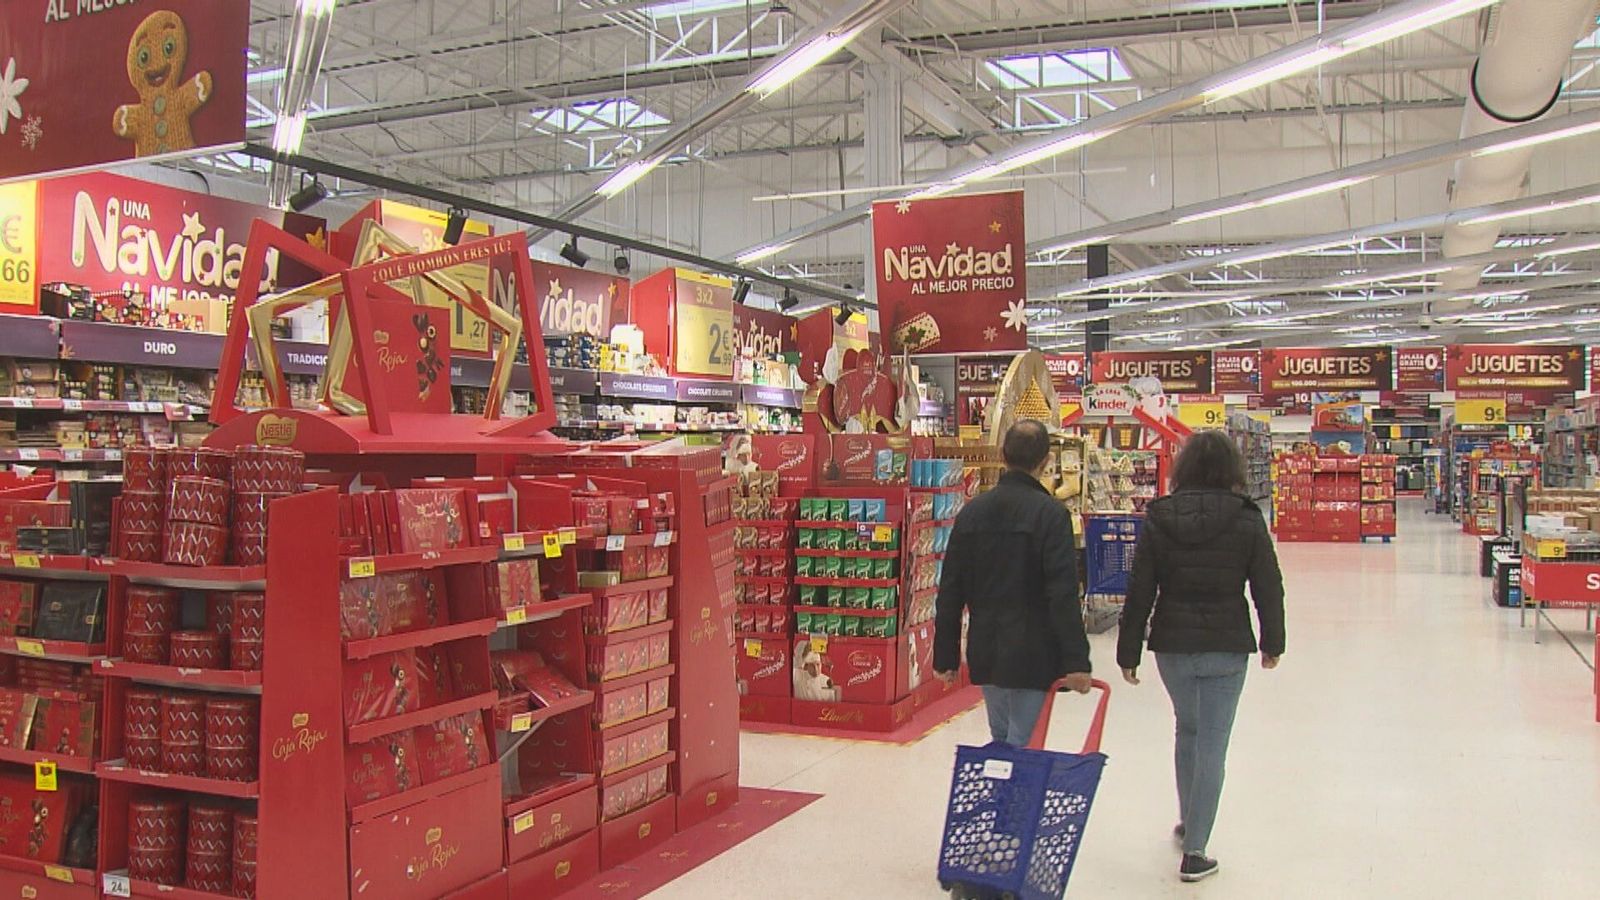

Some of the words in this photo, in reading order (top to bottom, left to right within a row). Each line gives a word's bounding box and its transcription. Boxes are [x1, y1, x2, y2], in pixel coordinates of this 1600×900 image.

[123, 200, 150, 220] UNA
[463, 246, 490, 261] ERES
[909, 245, 926, 253] UNA
[884, 242, 1013, 281] Navidad
[911, 282, 926, 294] AL
[930, 279, 967, 293] MEJOR
[972, 276, 1014, 290] PRECIO
[696, 286, 713, 305] 3x2
[144, 341, 176, 354] DURO
[1104, 360, 1192, 379] JUGUETES
[1279, 356, 1371, 376] JUGUETES
[1465, 353, 1564, 374] JUGUETES
[613, 381, 642, 391] CHOCOLATE
[1089, 396, 1127, 409] Kinder
[1206, 409, 1216, 424] 9
[1484, 406, 1495, 421] 9
[1586, 573, 1600, 590] S
[272, 737, 296, 762] Caja
[295, 728, 328, 754] Roja
